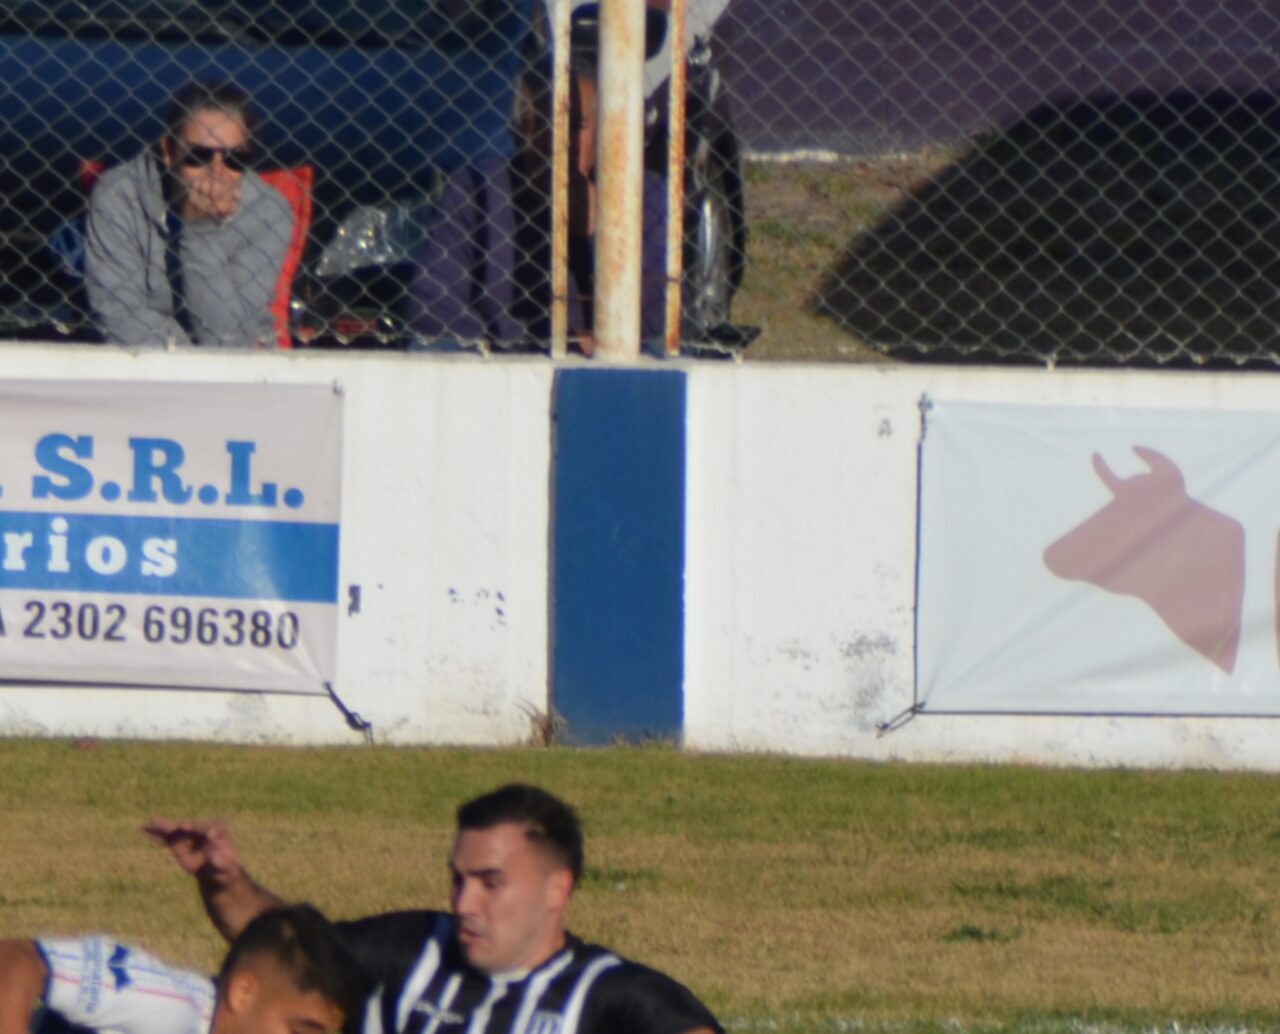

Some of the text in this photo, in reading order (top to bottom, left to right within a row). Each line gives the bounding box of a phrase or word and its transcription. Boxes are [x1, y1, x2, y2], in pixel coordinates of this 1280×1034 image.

[31, 432, 305, 509] S.R.L.
[23, 603, 127, 643] 2302
[141, 606, 301, 652] 696380
